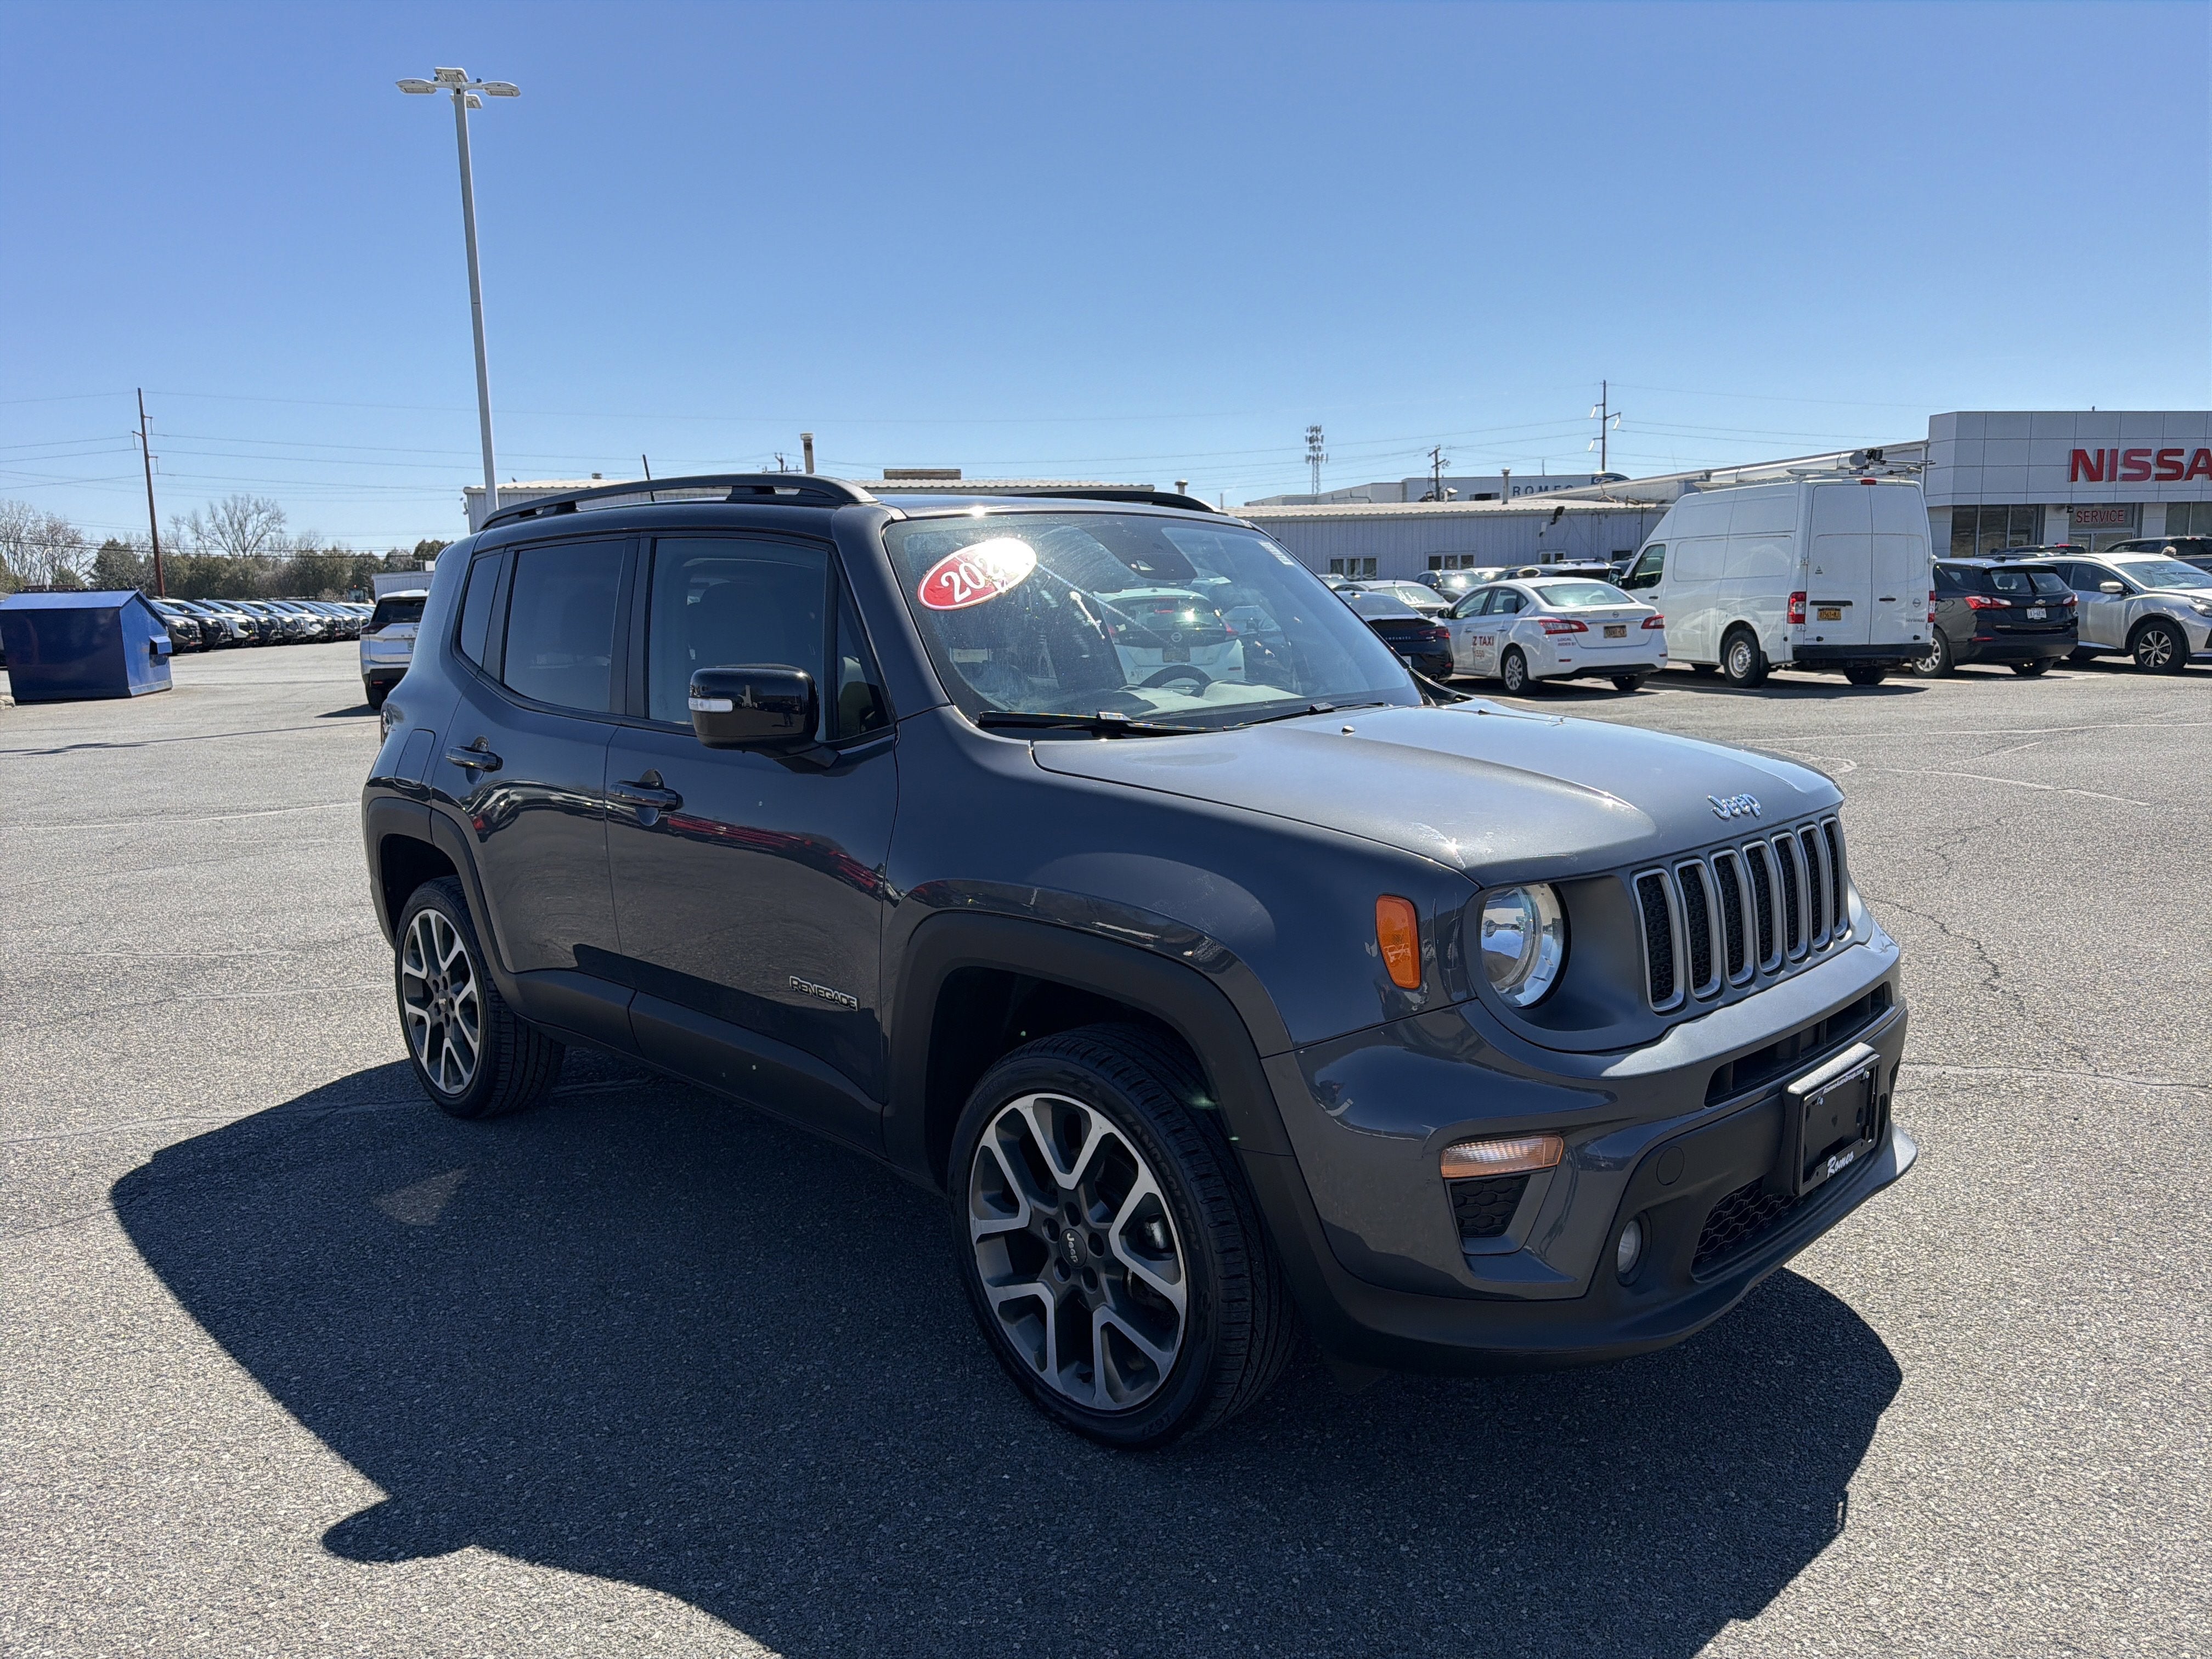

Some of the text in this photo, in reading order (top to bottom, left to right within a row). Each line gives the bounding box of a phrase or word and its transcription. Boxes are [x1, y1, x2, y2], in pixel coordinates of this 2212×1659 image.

[2076, 510, 2125, 523] SERVICE
[1472, 635, 1494, 646] Z TAXI
[1707, 794, 1761, 820] Jeep
[789, 975, 860, 1012] RENEGADE
[1827, 1150, 1854, 1178] Romeo
[1066, 1233, 1079, 1263] Jeep
